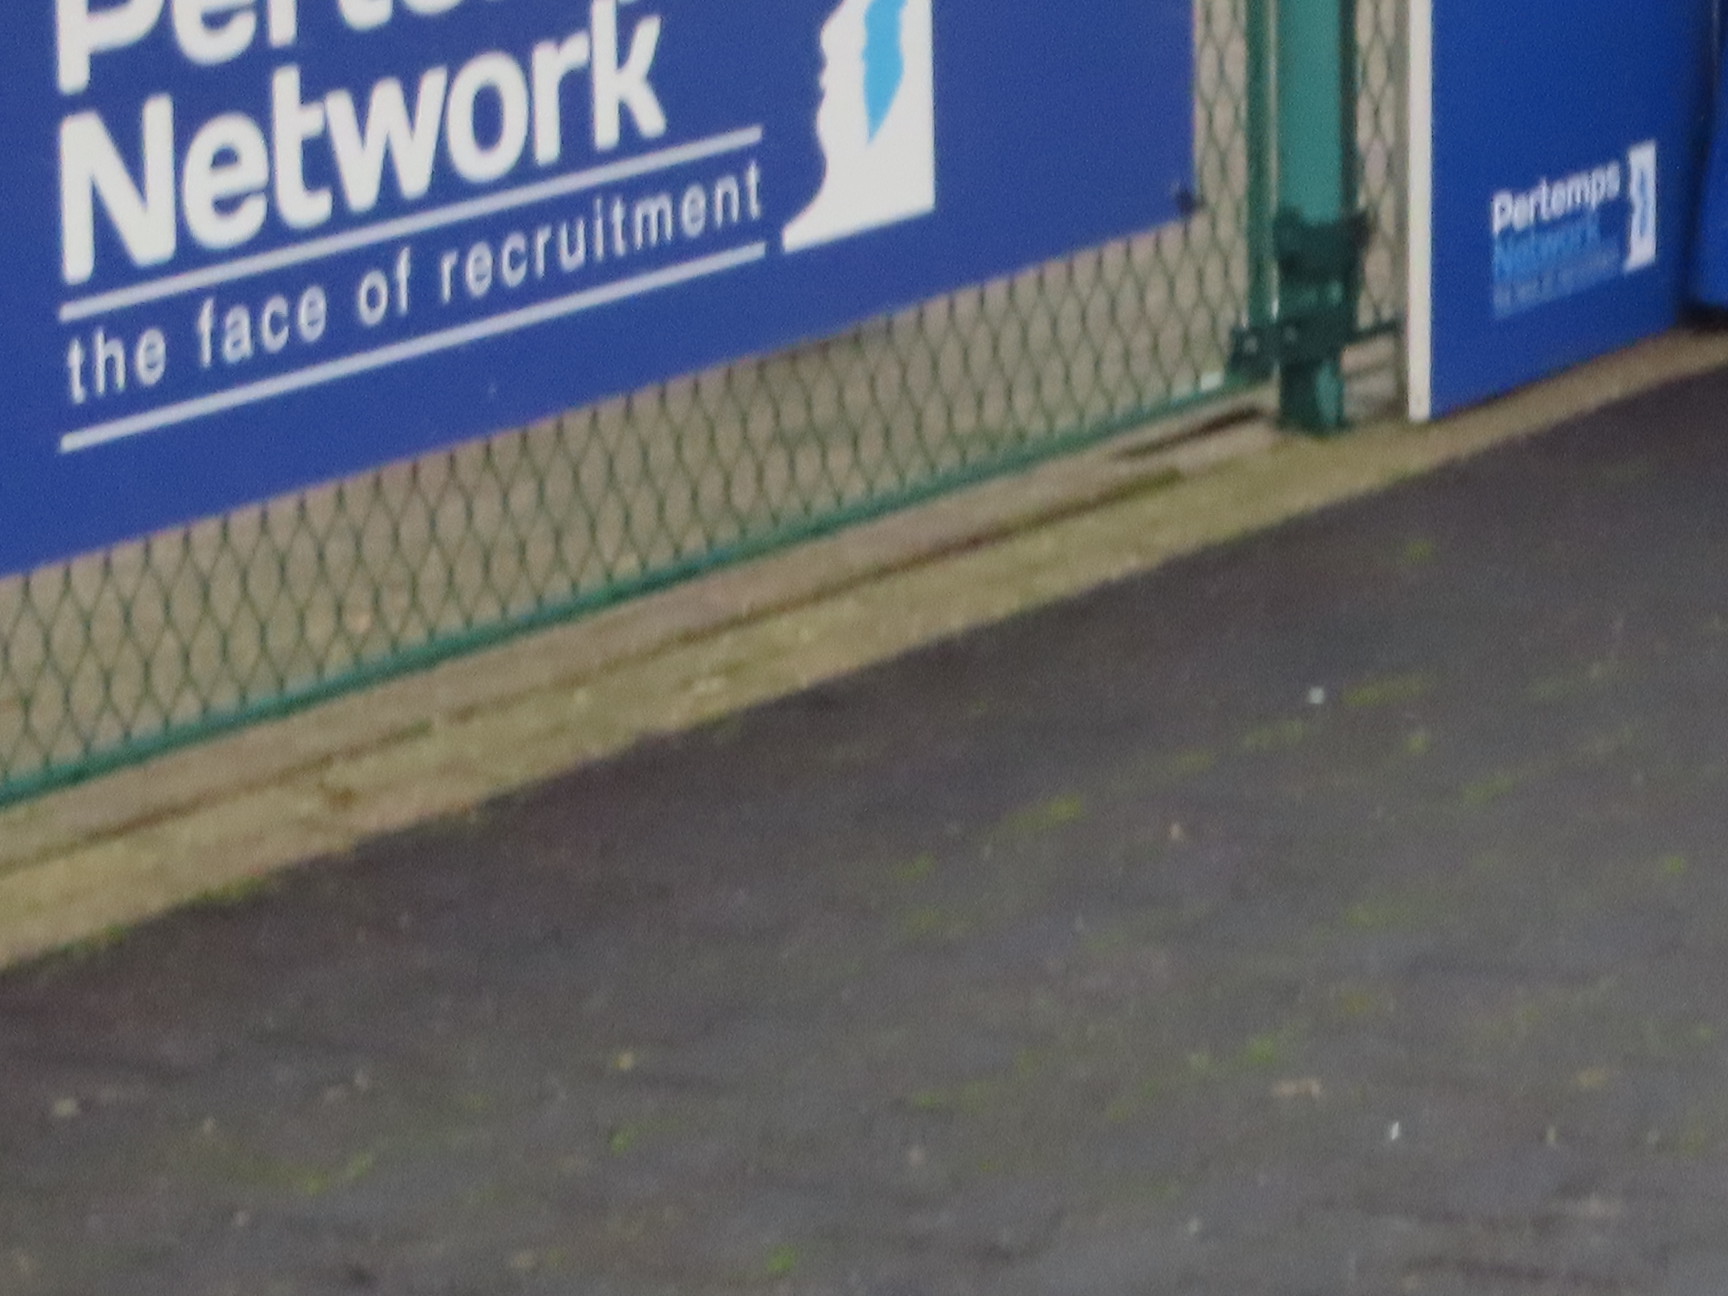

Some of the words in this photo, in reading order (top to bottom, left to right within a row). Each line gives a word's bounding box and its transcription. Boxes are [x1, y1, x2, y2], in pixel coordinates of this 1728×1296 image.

[1492, 160, 1621, 233] Pertemps
[67, 325, 167, 404] the
[199, 284, 328, 367] face
[357, 247, 413, 323] of
[440, 163, 763, 303] recruitment
